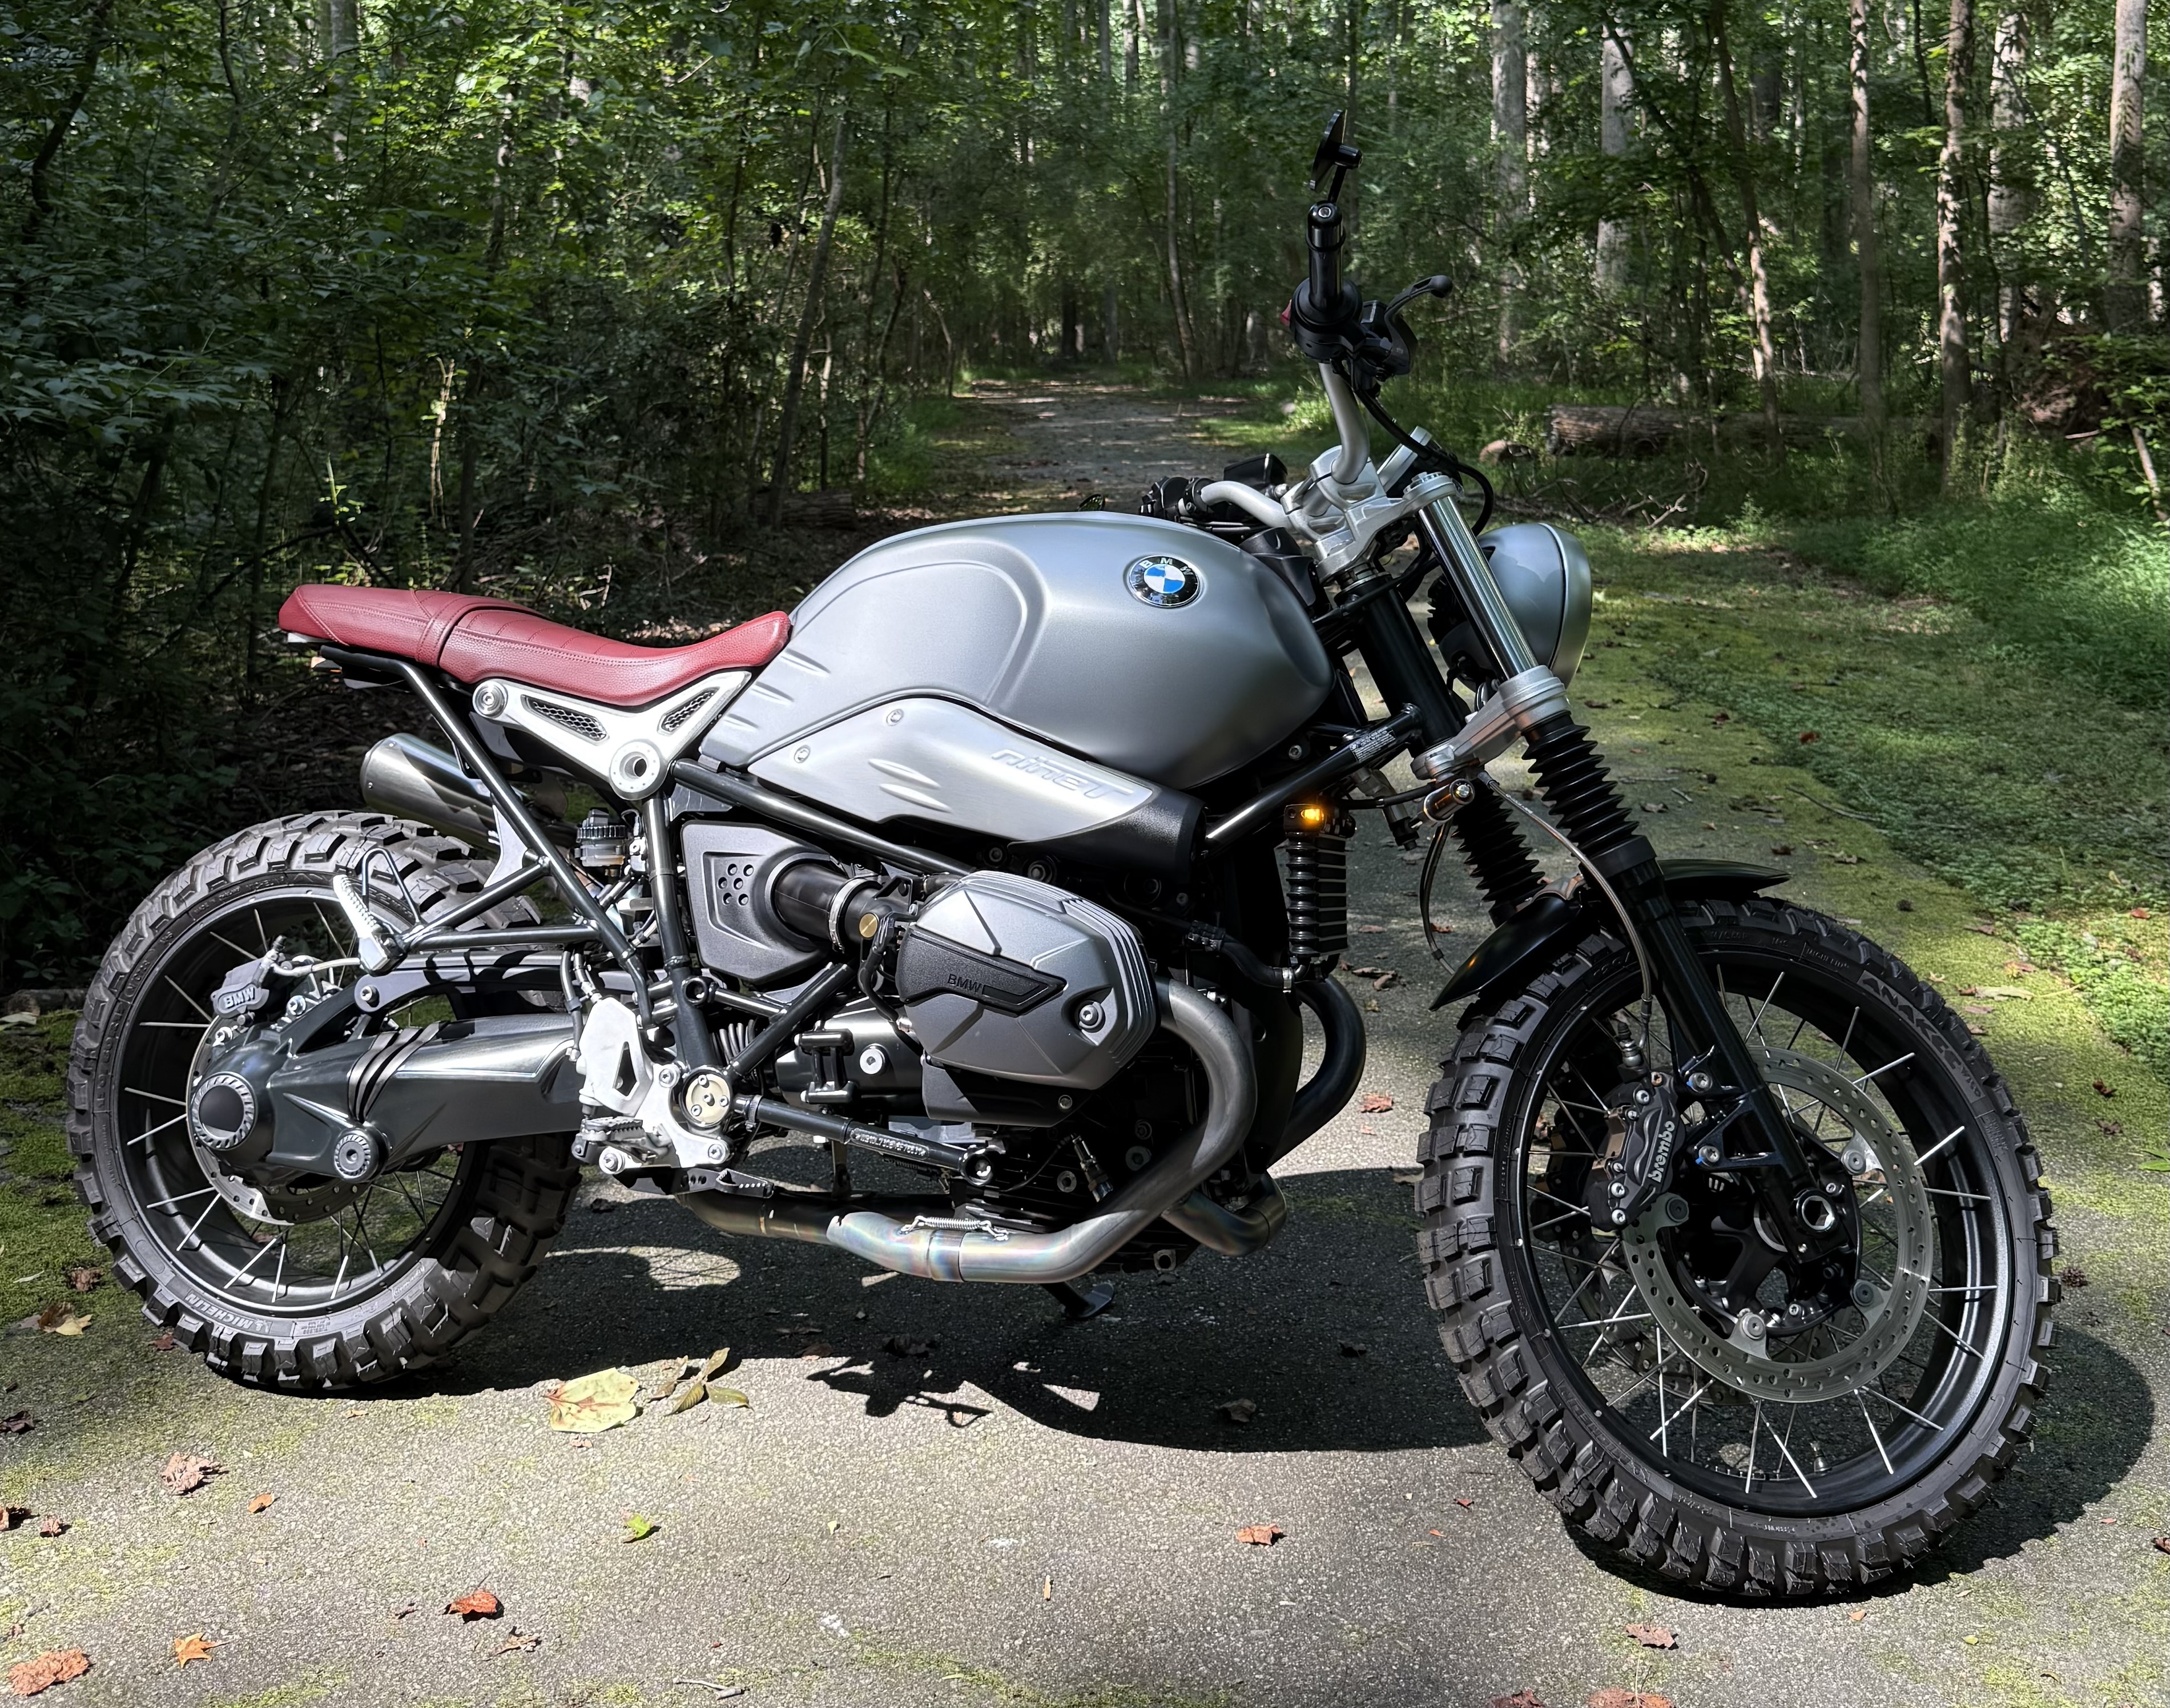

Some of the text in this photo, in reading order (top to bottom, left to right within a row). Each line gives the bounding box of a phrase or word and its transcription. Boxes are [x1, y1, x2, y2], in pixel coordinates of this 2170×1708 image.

[1139, 557, 1193, 576] BMW
[223, 986, 256, 1009] BMW
[947, 973, 983, 993] BMW
[1862, 977, 1962, 1070] ANAKEE
[1648, 1121, 1675, 1183] brembo
[185, 1293, 253, 1330] MICHELIN
[1557, 1383, 1630, 1466] MICHELIN
